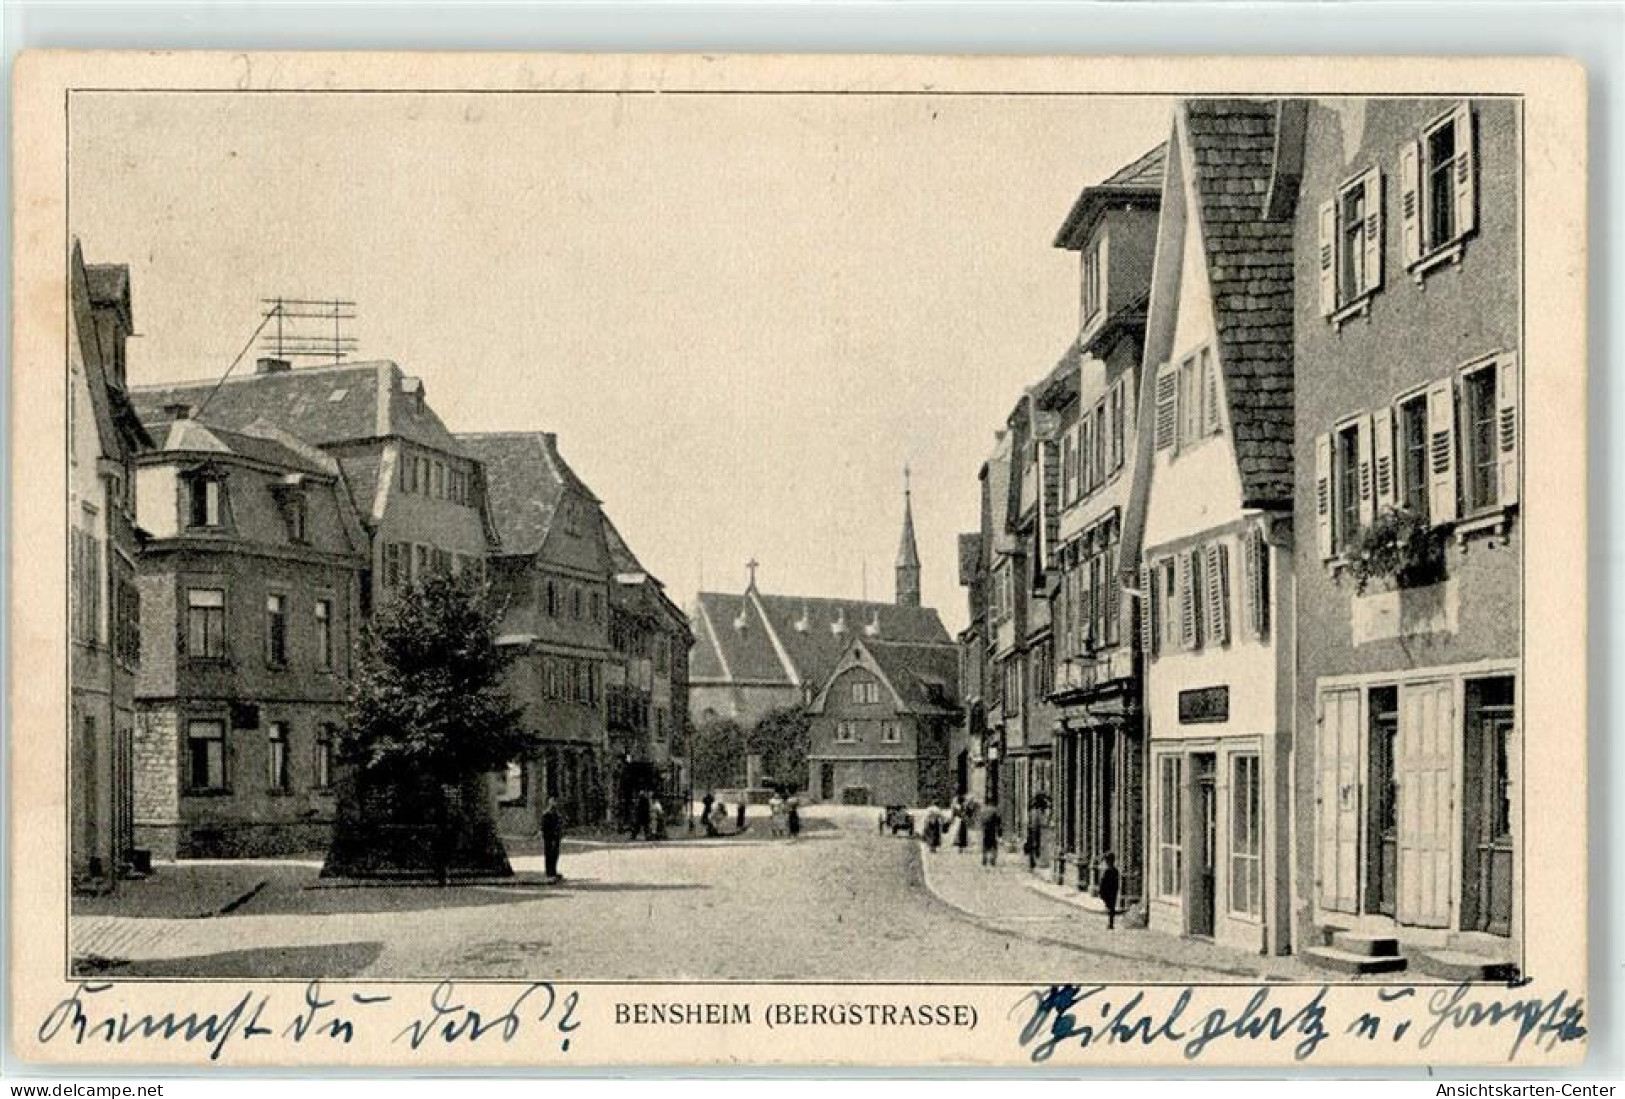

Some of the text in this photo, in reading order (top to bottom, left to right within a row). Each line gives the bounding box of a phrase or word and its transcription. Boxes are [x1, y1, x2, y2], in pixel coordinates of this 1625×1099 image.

[38, 982, 271, 1061] Kennst
[282, 981, 391, 1044] du
[615, 1003, 979, 1030] BENSHEIM (BERGSTRASSE)
[1345, 987, 1415, 1042] u.
